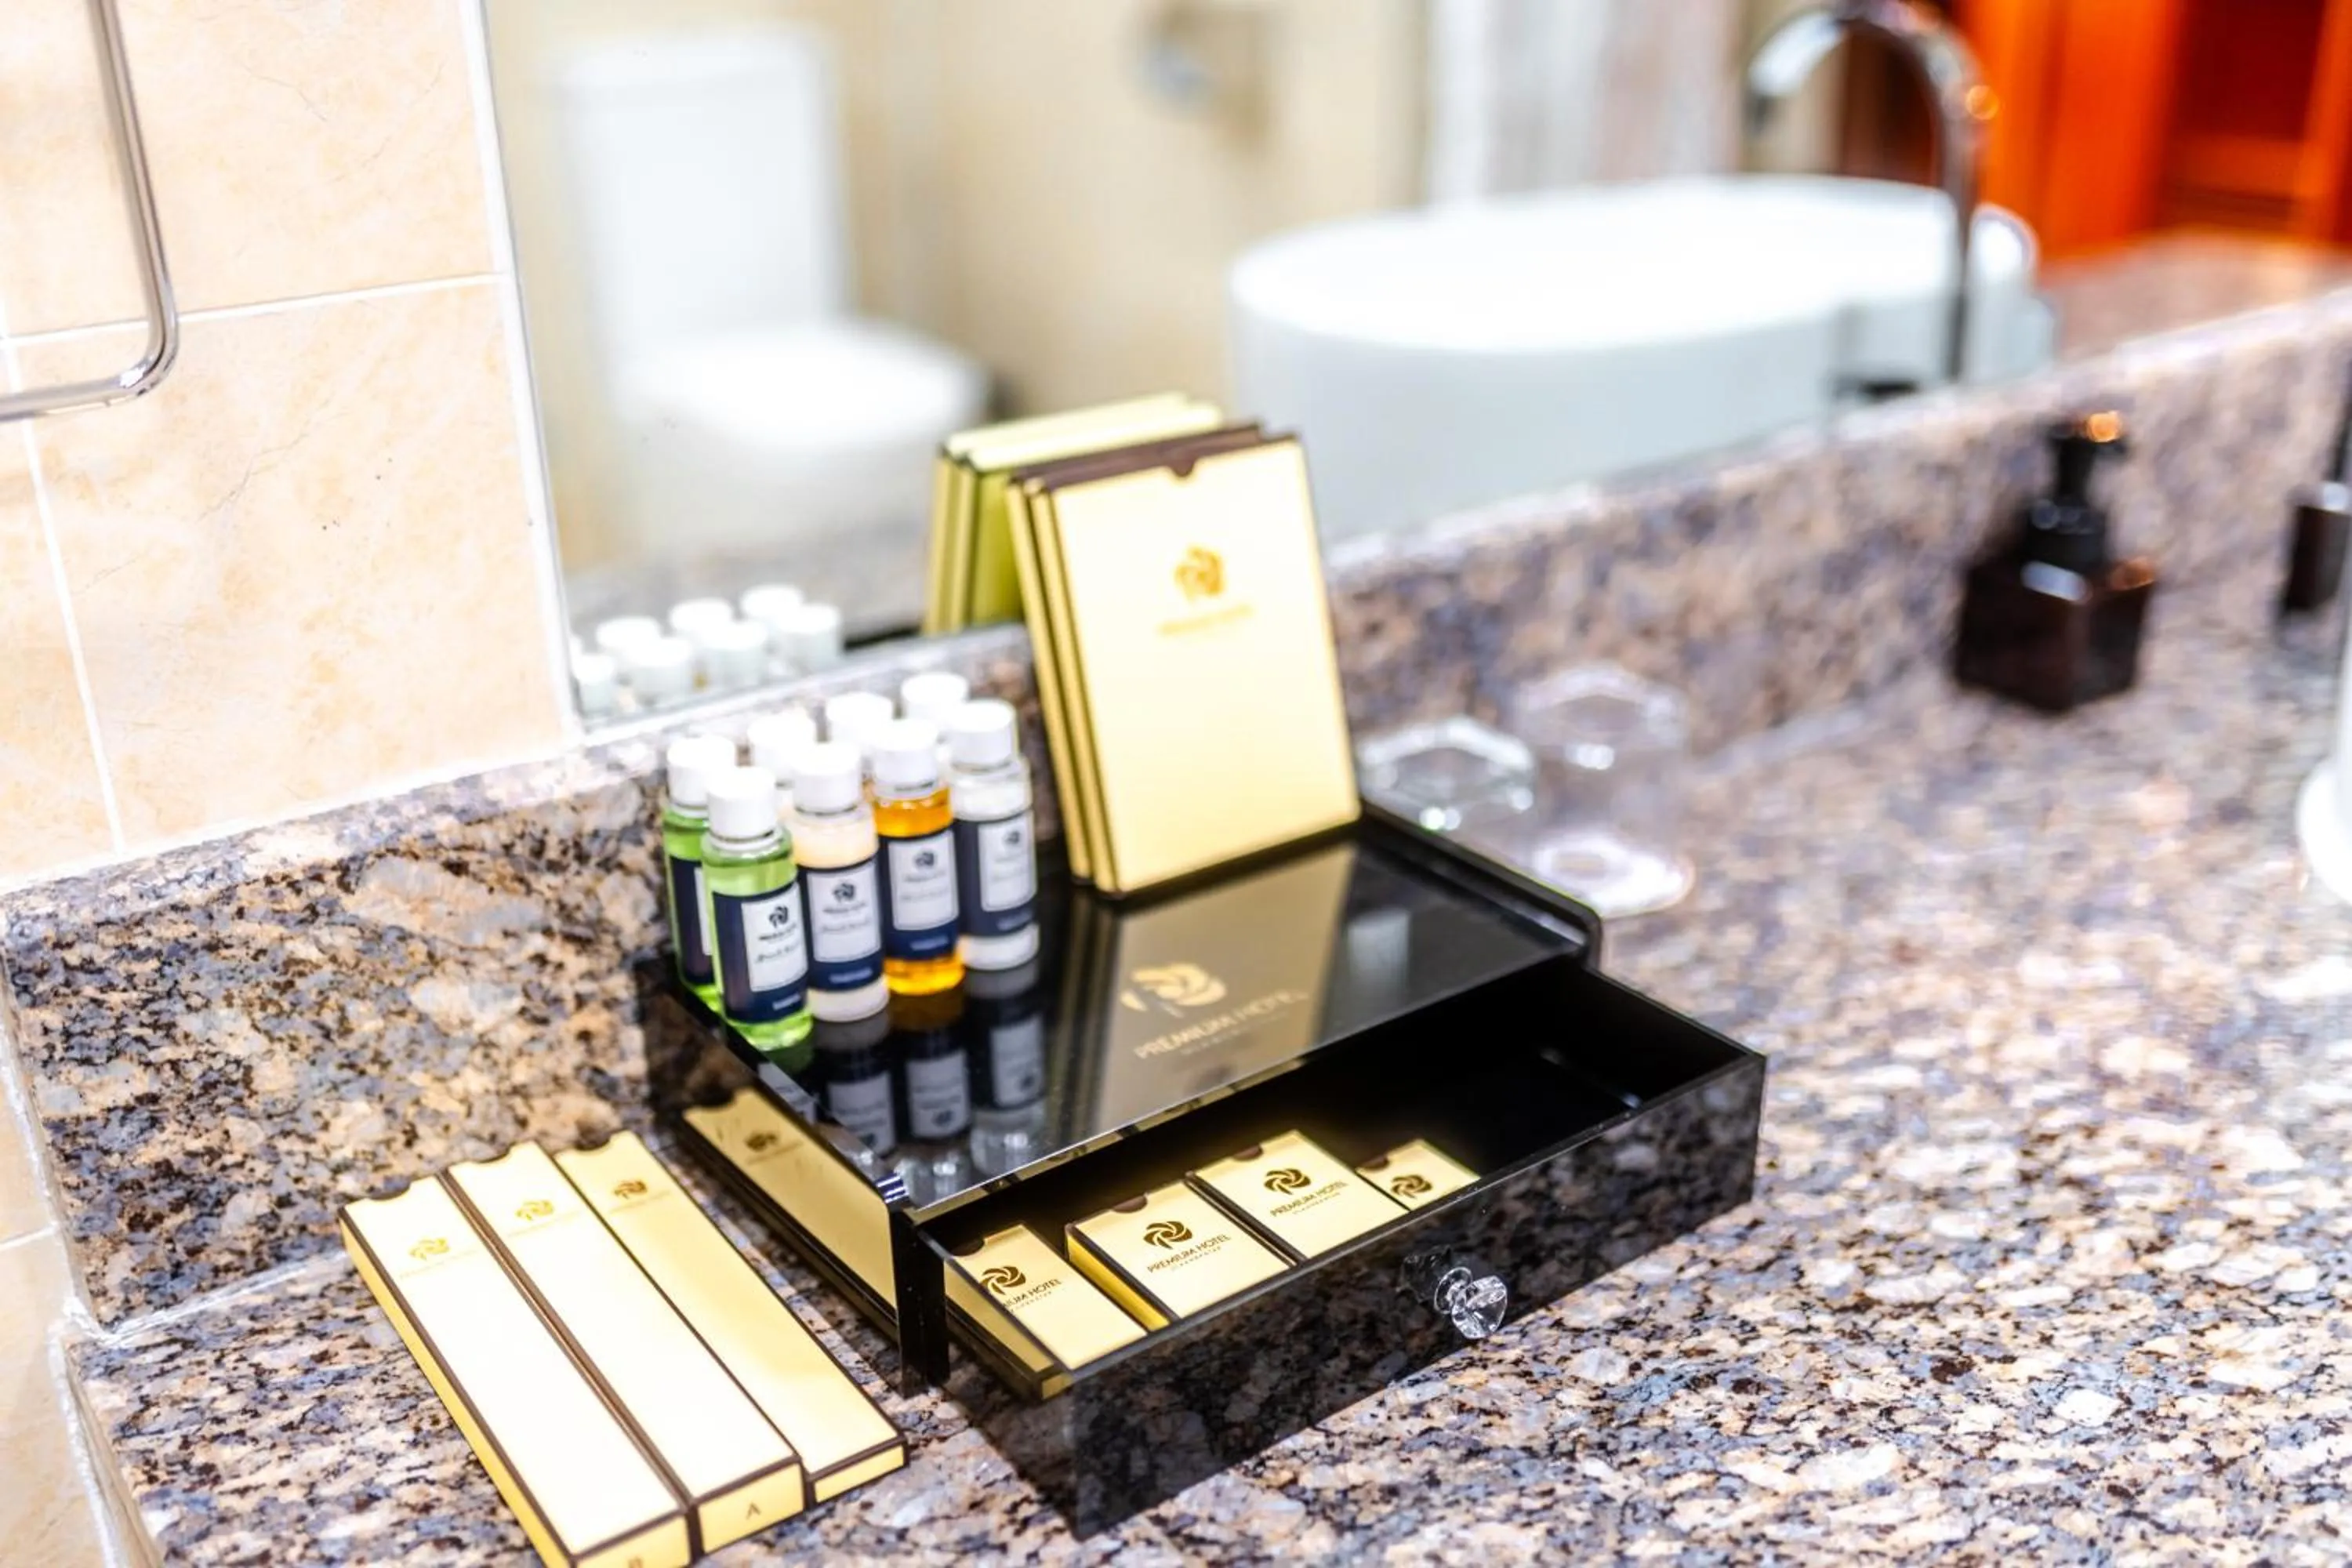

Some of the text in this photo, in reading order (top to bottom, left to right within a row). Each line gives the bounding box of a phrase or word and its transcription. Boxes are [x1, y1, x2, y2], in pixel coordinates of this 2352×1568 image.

[1270, 1194, 1317, 1217] PREMIUM
[1147, 1248, 1197, 1273] PREMIUM
[1195, 1233, 1231, 1250] HOTEL
[1027, 1279, 1062, 1296] HOTEL
